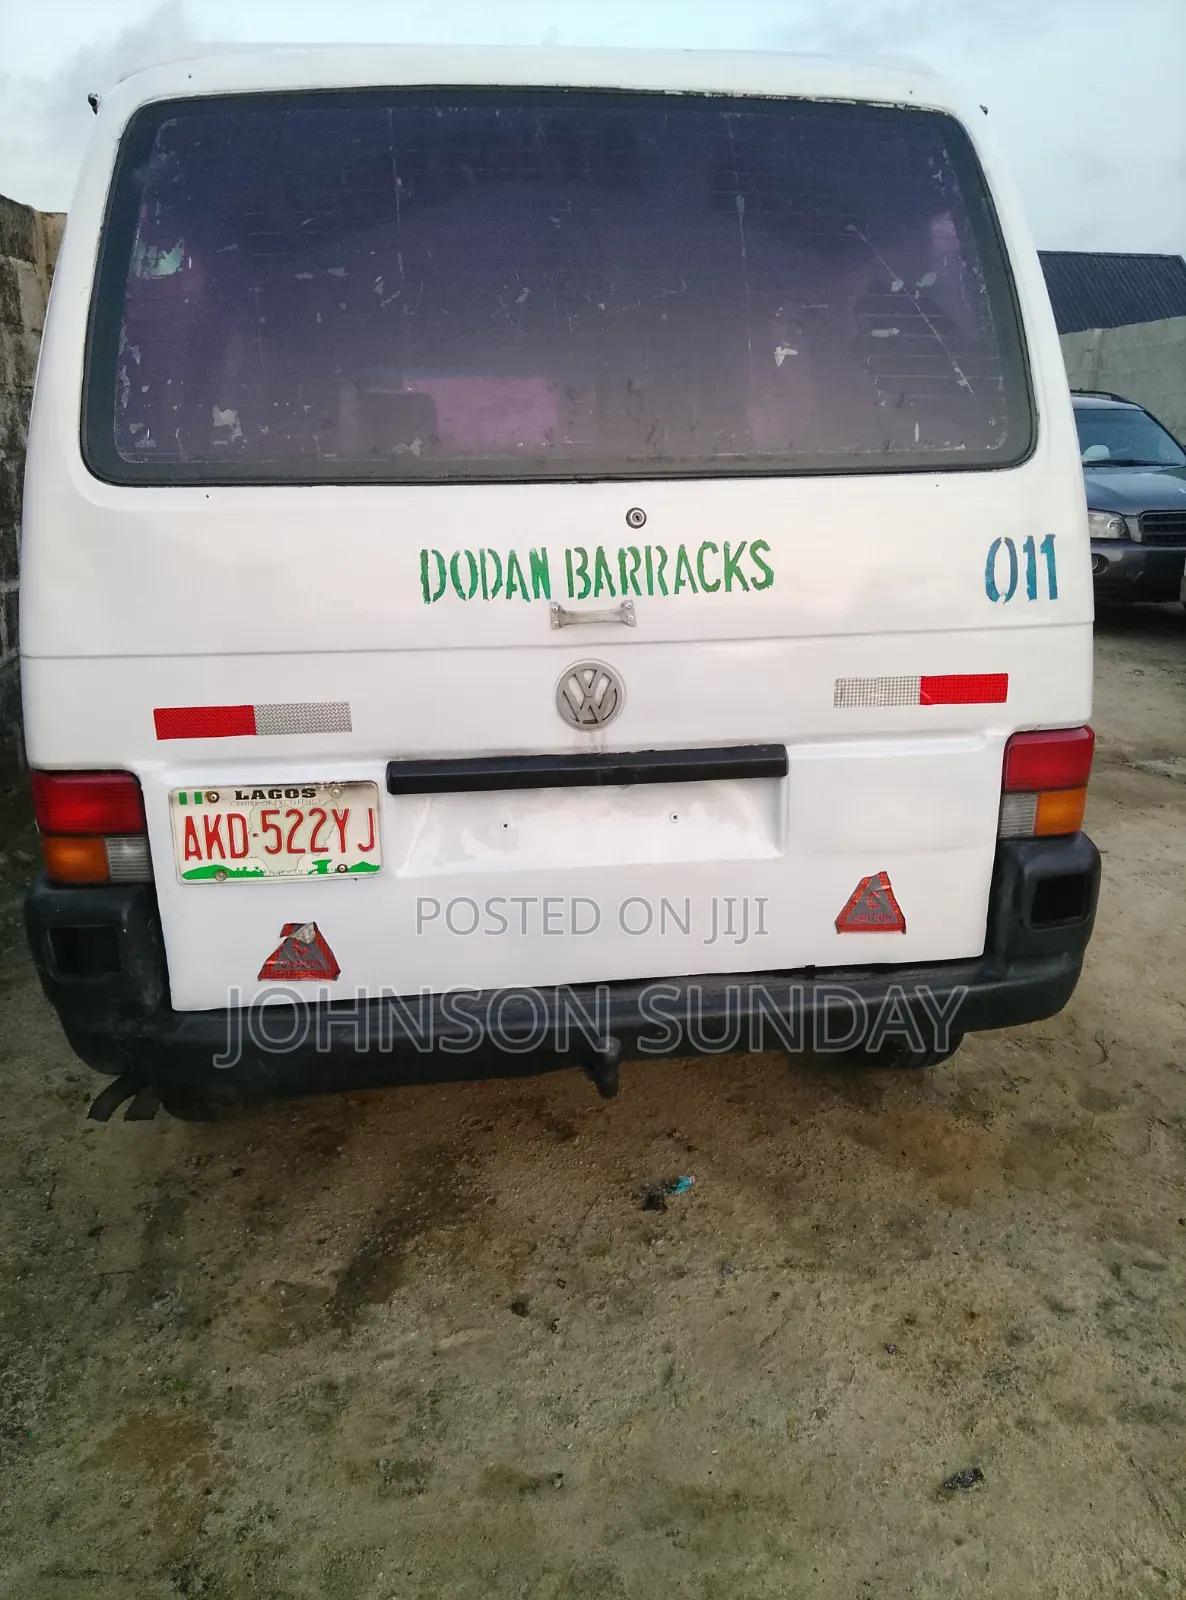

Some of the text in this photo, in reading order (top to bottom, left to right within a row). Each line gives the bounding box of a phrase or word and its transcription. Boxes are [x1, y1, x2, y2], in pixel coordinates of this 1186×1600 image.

[420, 538, 774, 604] DODAN BARRACKS
[984, 533, 1058, 604] 011
[234, 788, 317, 800] LAGOS
